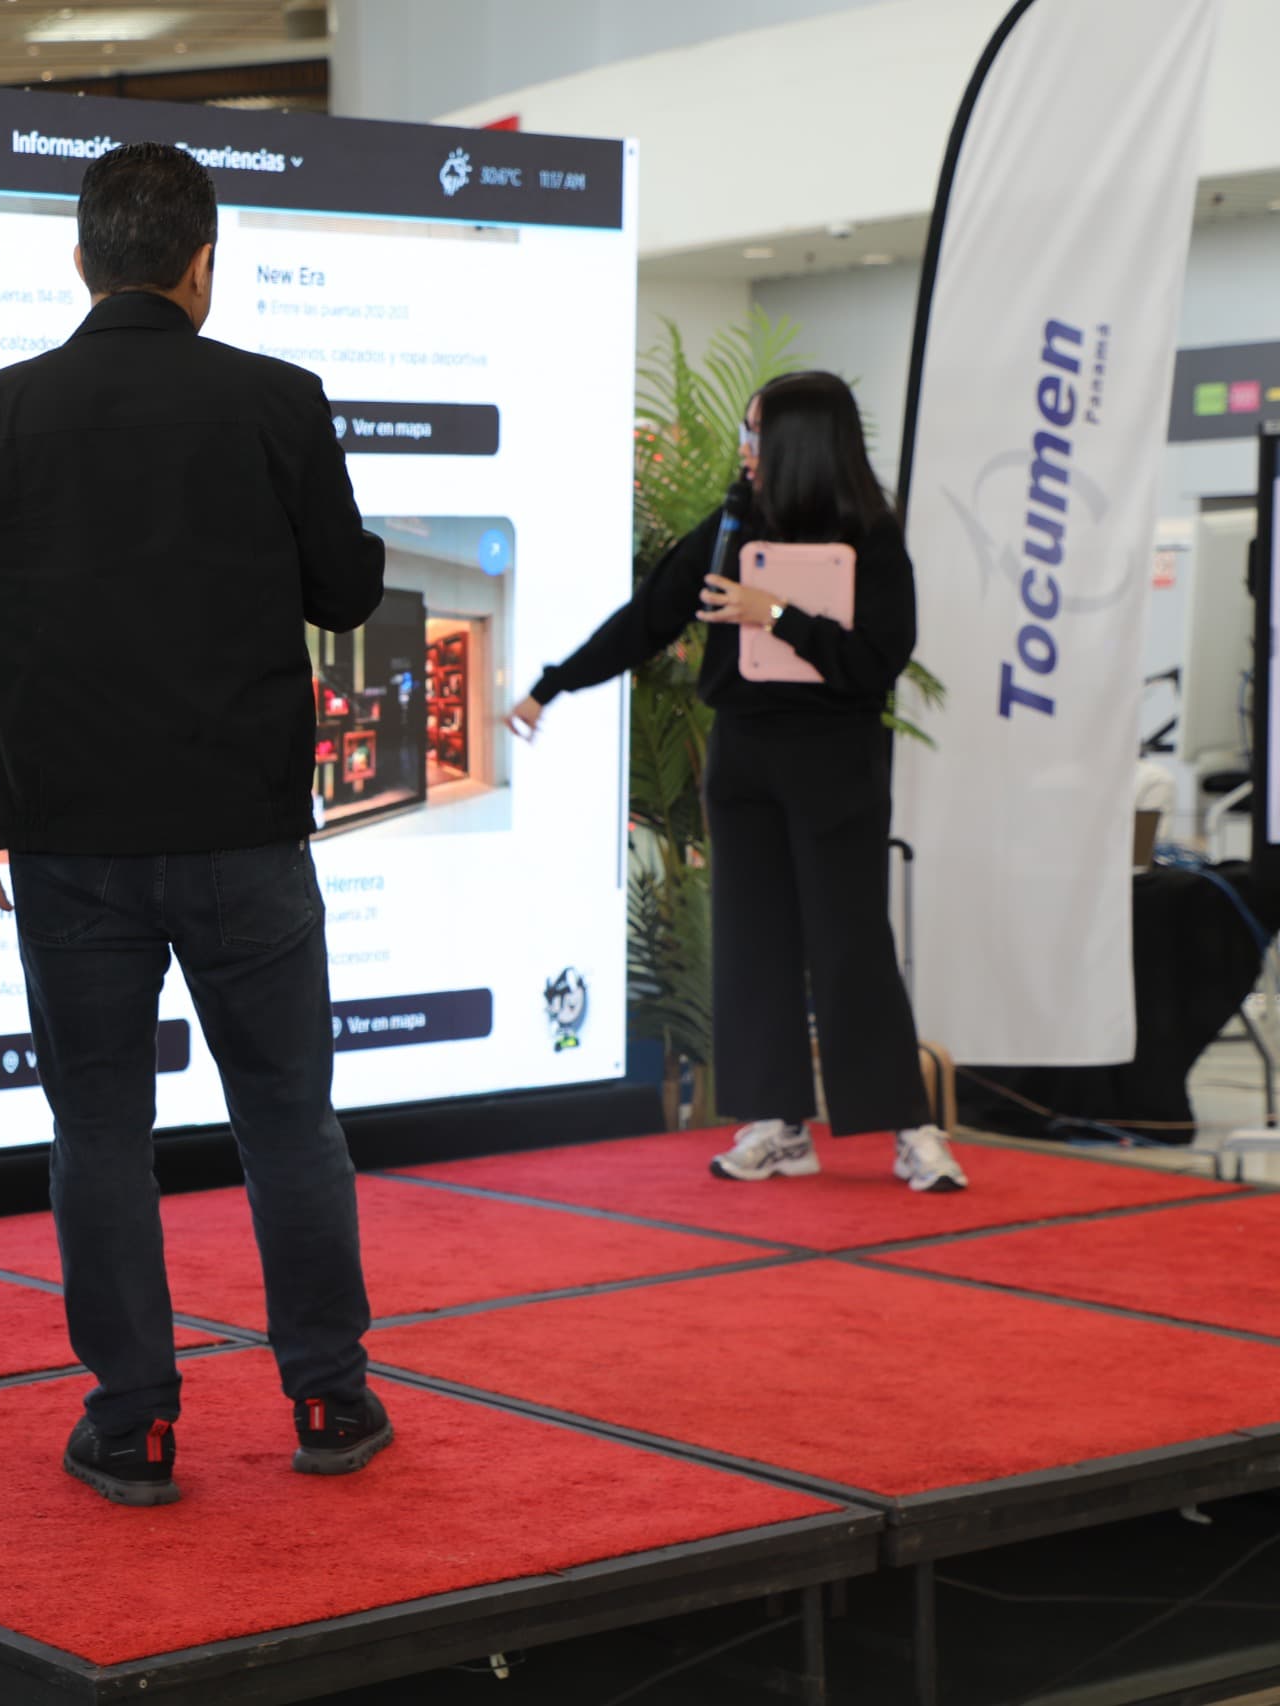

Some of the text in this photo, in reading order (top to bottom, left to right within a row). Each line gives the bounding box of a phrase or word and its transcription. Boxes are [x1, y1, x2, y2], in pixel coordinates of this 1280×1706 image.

[257, 265, 326, 287] New Era
[352, 418, 432, 439] Ver en mapa
[997, 317, 1084, 720] Tocumen
[326, 875, 384, 894] Herrera
[347, 1012, 427, 1034] Ver en mapa
